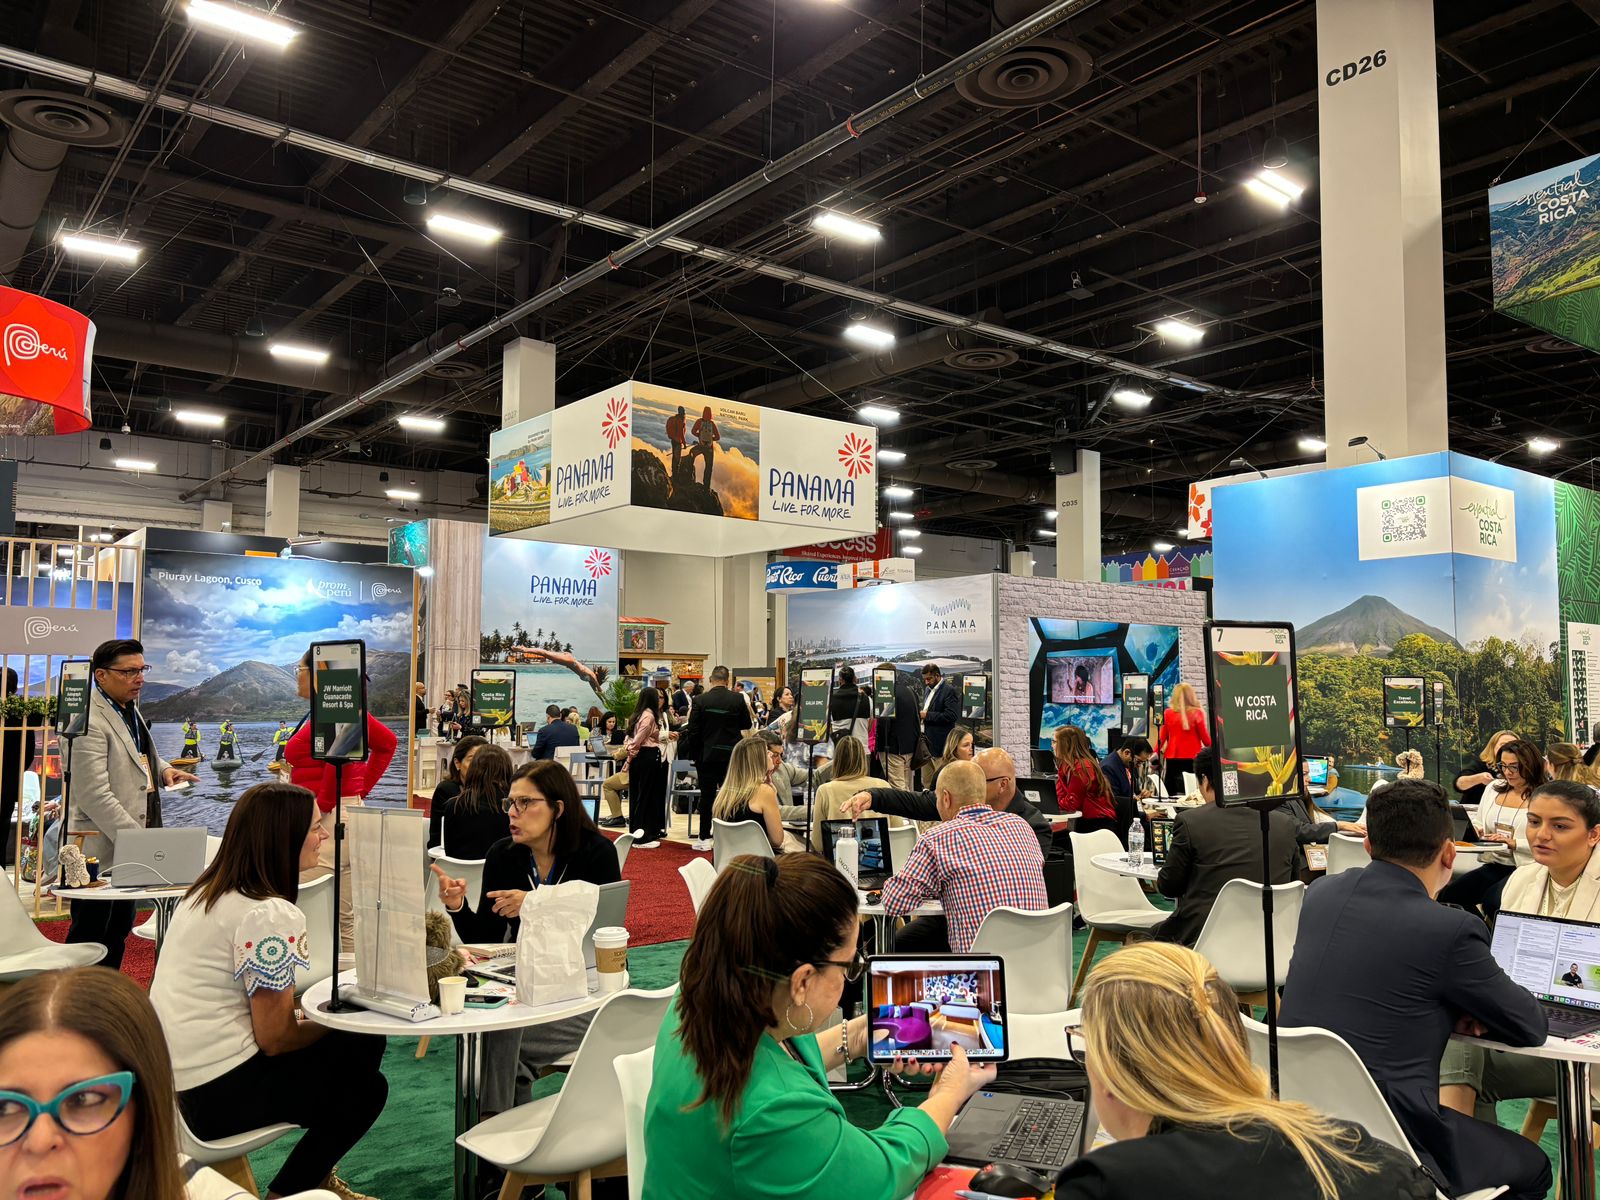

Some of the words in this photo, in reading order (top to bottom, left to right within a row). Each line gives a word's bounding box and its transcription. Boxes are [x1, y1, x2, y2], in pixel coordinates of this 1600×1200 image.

[1326, 50, 1386, 86] CD26
[1498, 170, 1595, 206] essential
[1538, 188, 1590, 212] COSTA
[1539, 205, 1576, 224] RICA
[4, 323, 68, 366] Perú
[556, 452, 614, 495] PANAMA
[769, 468, 854, 506] PANAMA
[558, 496, 573, 508] LIVE
[575, 490, 588, 504] FOR
[590, 486, 611, 504] MORE
[772, 500, 797, 514] LIVE
[800, 504, 820, 517] FOR
[821, 506, 852, 521] MORE
[1459, 499, 1506, 521] essential
[1479, 518, 1502, 534] COSTA
[1480, 532, 1498, 546] RICA
[158, 572, 192, 582] Piuray
[194, 574, 232, 584] Lagoon,
[235, 576, 262, 586] Cusco
[780, 566, 804, 584] Rico
[812, 566, 838, 584] Puert
[318, 580, 347, 590] prom
[326, 588, 352, 598] perú
[530, 575, 596, 597] PANAMA
[533, 596, 552, 604] LIVE
[554, 596, 570, 605] FOR
[570, 598, 594, 608] MORE
[24, 616, 79, 645] Perú
[926, 620, 976, 630] PANAMA
[1216, 628, 1224, 642] 7
[316, 646, 320, 655] 8
[332, 684, 352, 692] Marriott
[1234, 696, 1245, 707] W
[1247, 695, 1276, 707] COSTA
[1246, 710, 1268, 720] RICA
